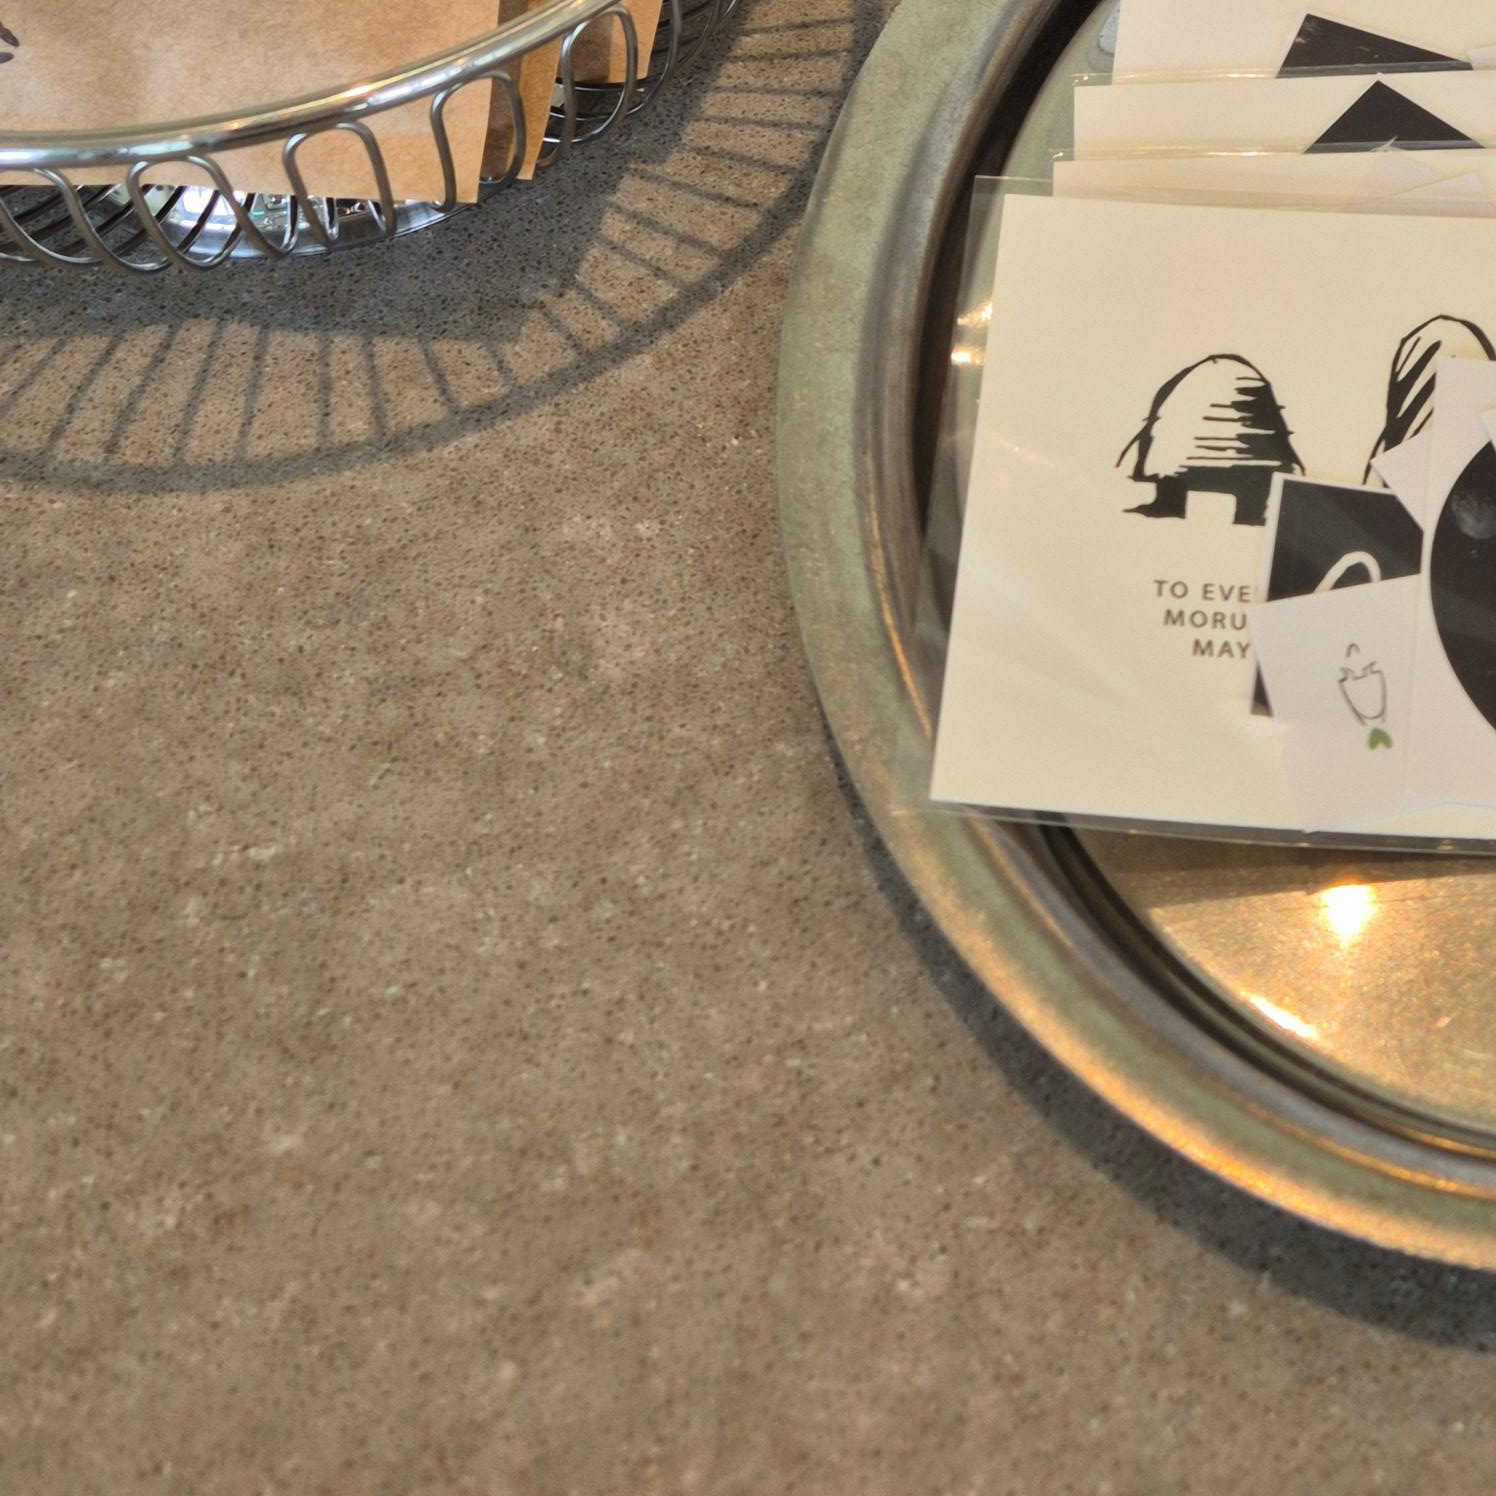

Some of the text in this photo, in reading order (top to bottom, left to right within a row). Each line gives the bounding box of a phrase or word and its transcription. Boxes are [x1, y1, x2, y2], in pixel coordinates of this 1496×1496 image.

[1153, 579, 1189, 599] TO
[1163, 608, 1248, 631] MORU
[1191, 638, 1251, 659] MAY
